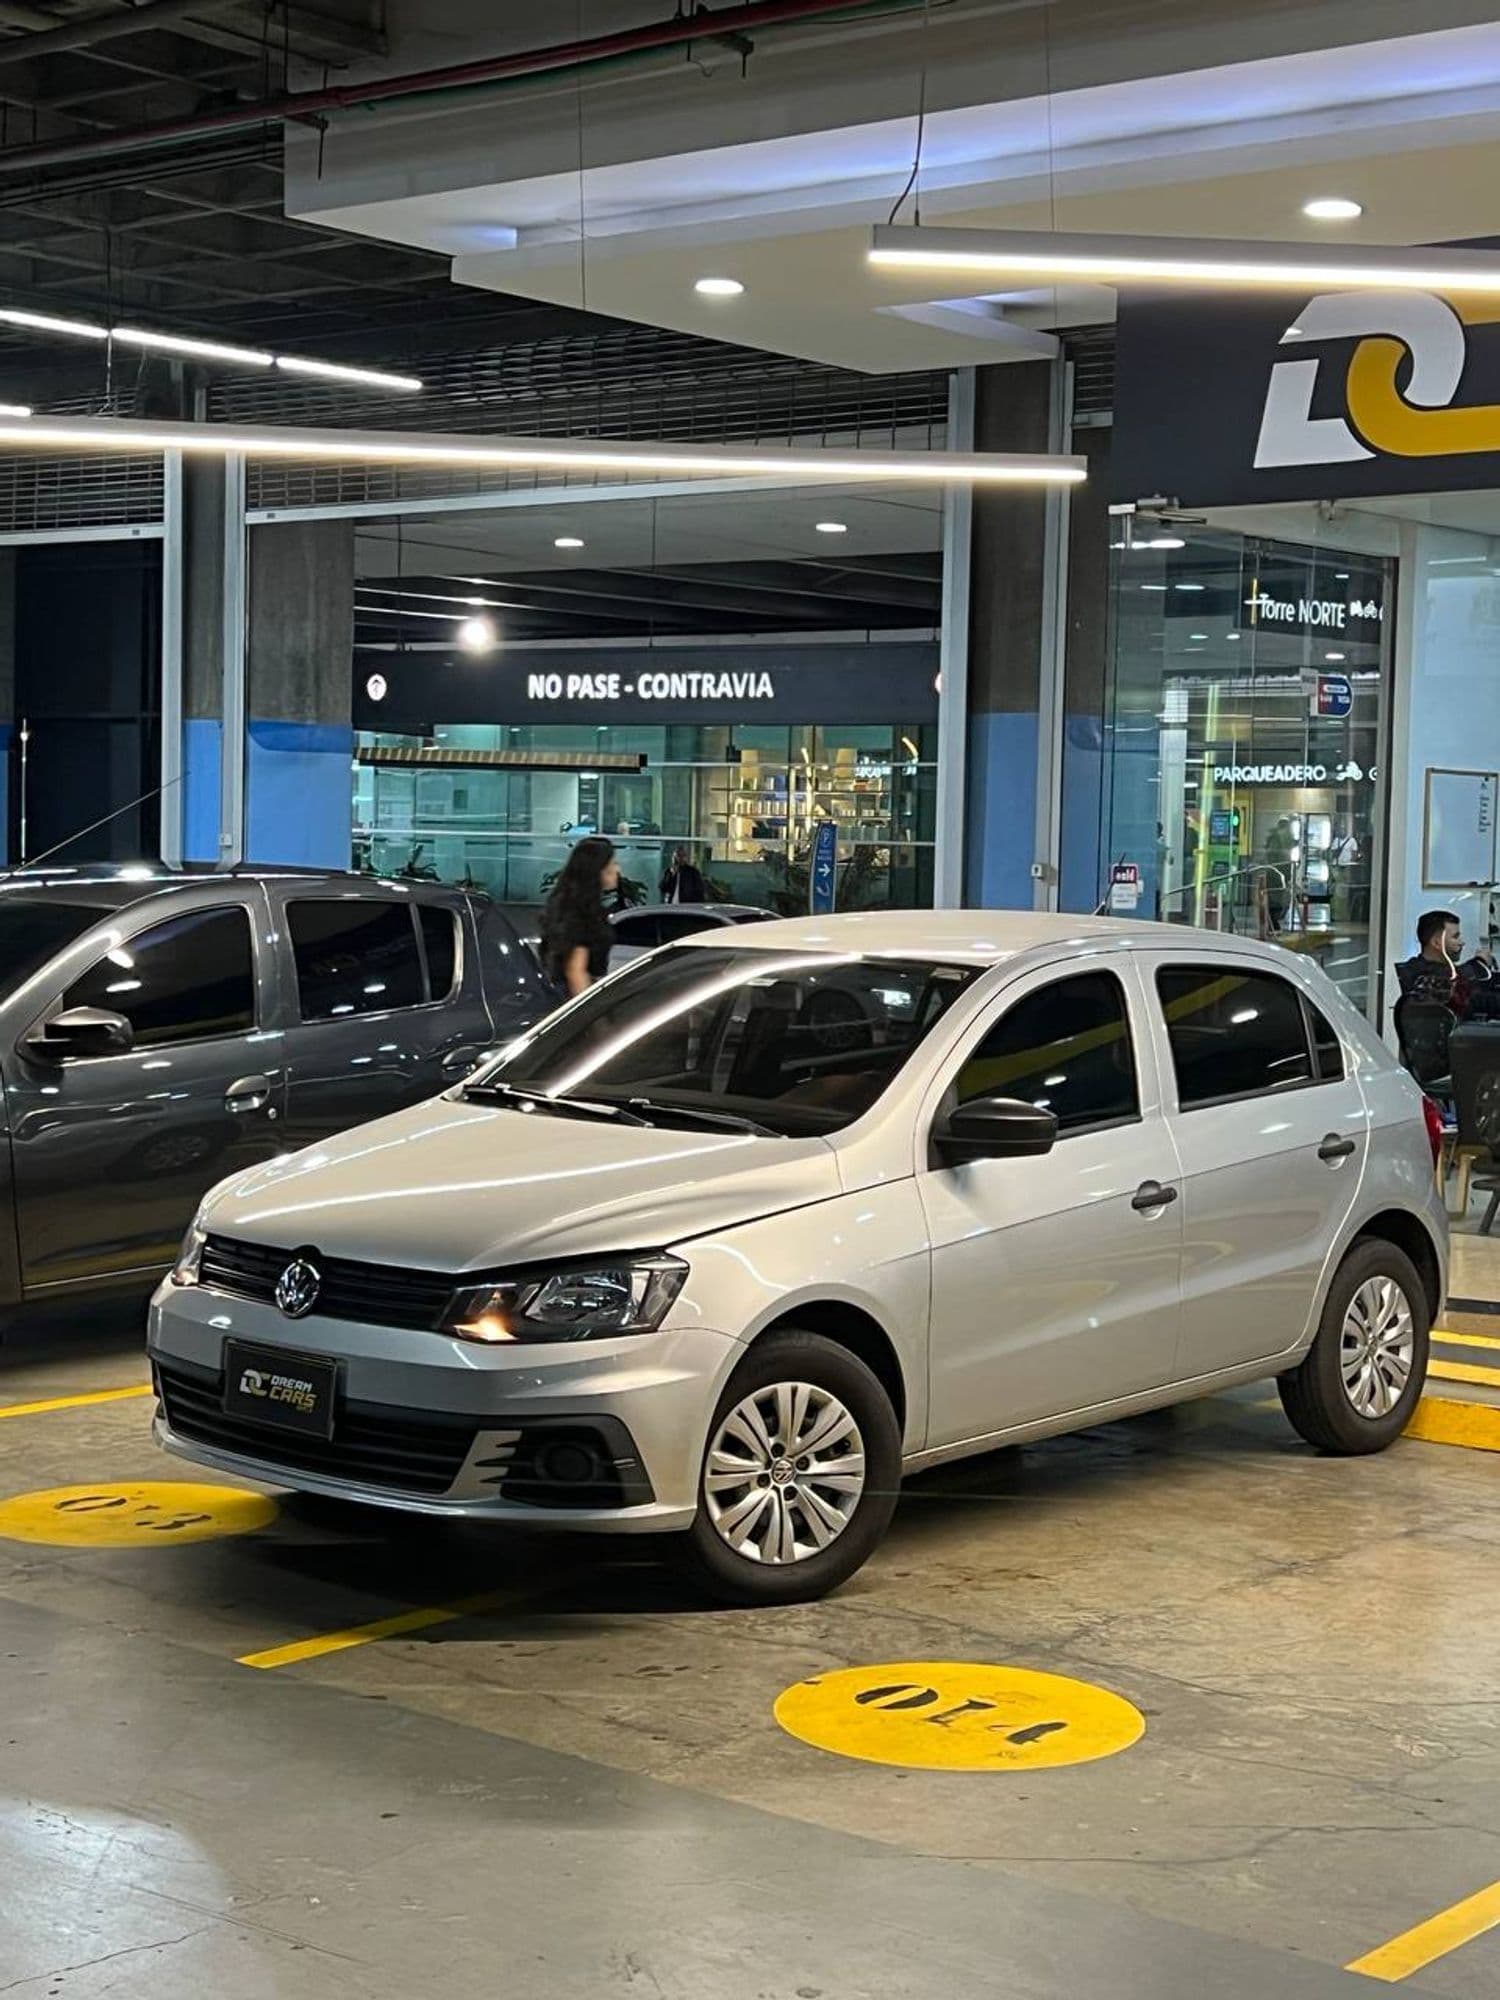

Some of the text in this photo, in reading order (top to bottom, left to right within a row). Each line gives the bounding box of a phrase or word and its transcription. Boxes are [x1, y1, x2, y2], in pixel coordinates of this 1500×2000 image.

[1258, 598, 1346, 629] Torre NORTE
[528, 673, 562, 699] NO
[566, 673, 620, 699] PASE
[637, 672, 774, 699] CONTRAVIA
[1213, 765, 1327, 782] PARQUEADERO
[271, 1374, 313, 1393] DREAM
[269, 1386, 317, 1408] CARS
